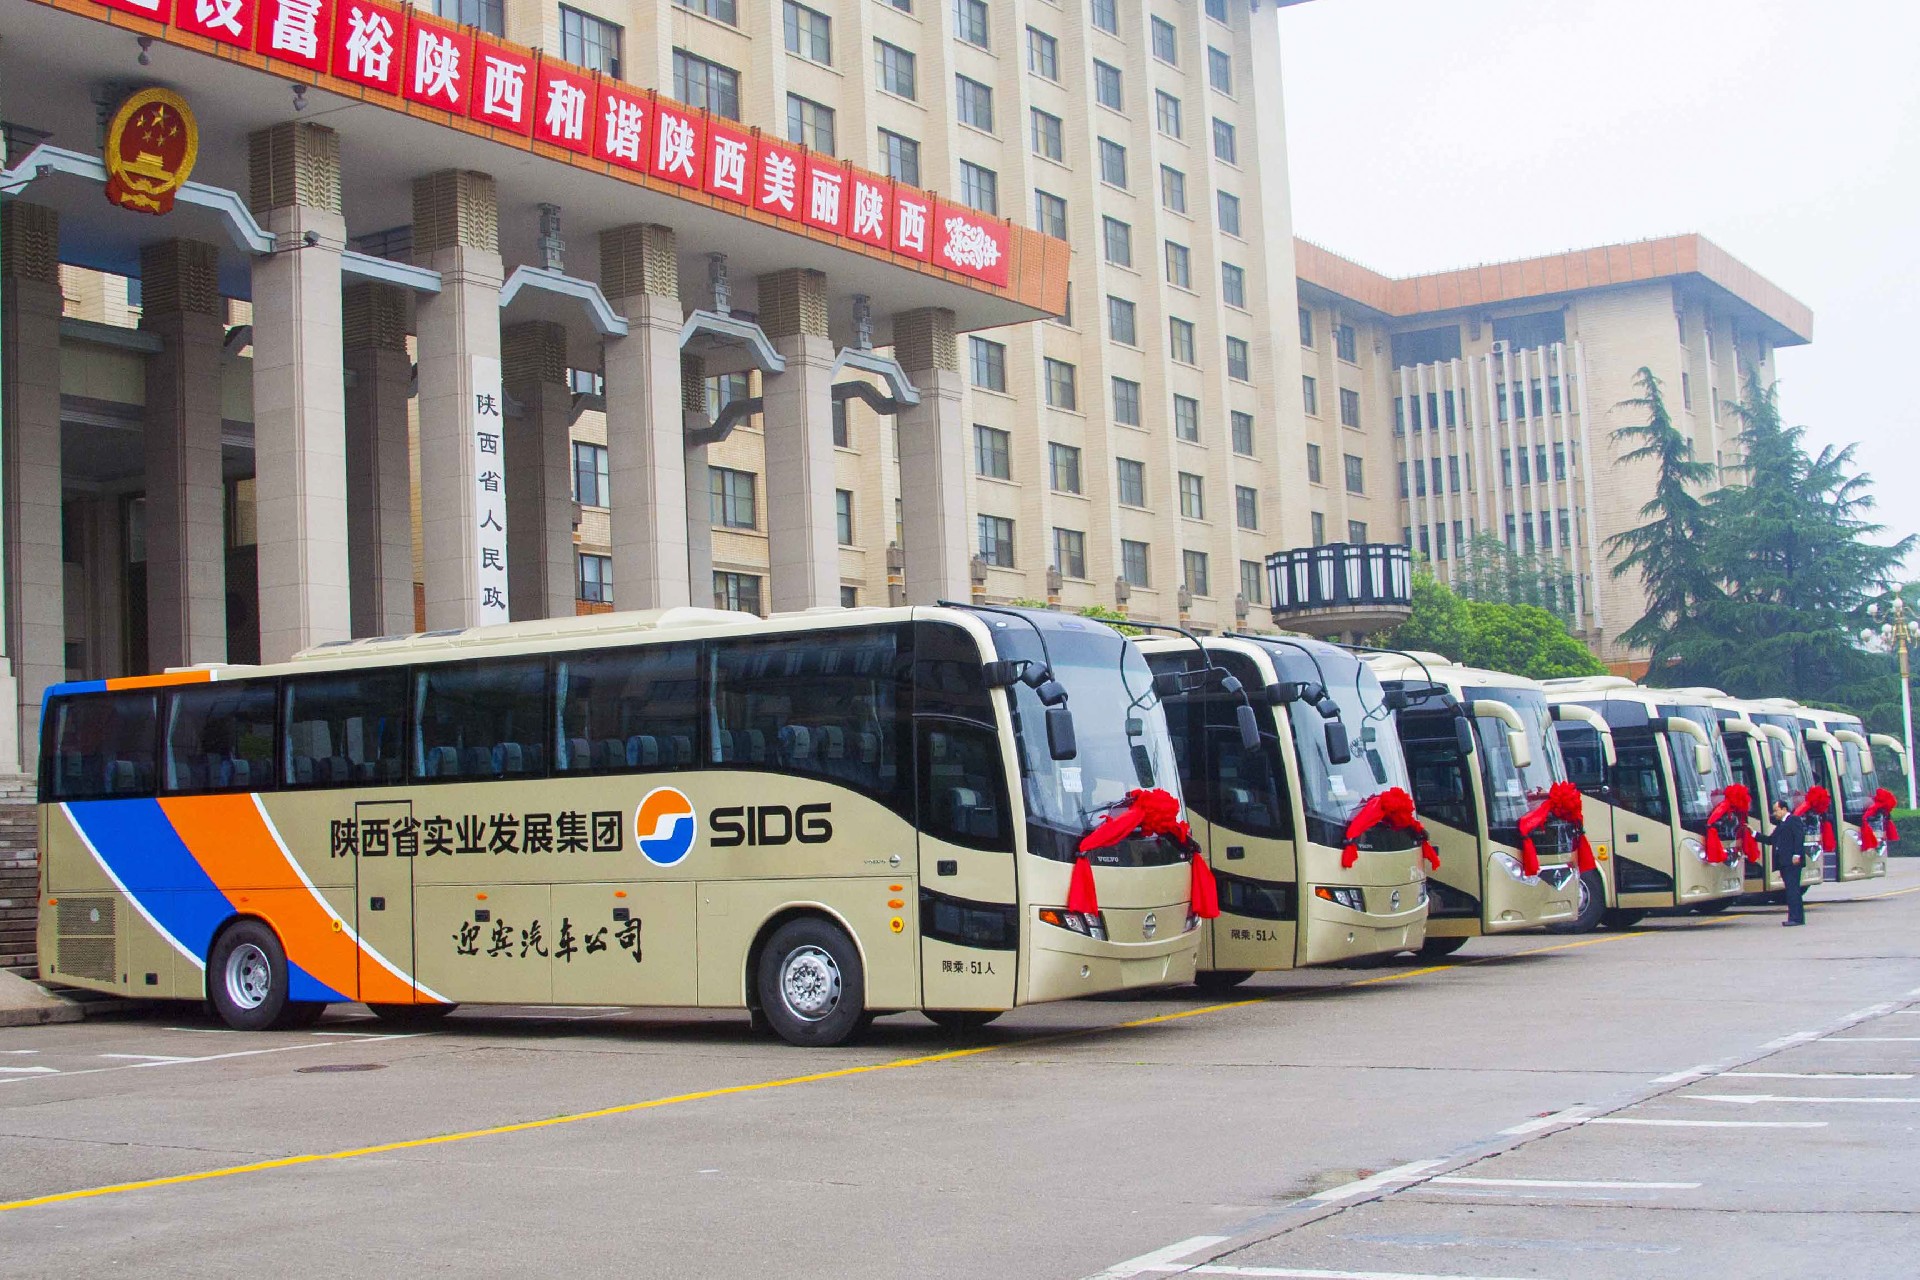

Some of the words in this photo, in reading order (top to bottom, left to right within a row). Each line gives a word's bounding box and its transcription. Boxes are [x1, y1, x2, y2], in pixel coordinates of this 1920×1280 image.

[129, 0, 927, 252] 设富裕陕西和谐陕西美丽陕西
[476, 394, 506, 609] 陕西省人民政
[330, 811, 623, 858] 陕西省实业发展集团
[709, 802, 832, 847] SIDG
[452, 917, 642, 963] 迎宾汽车公司
